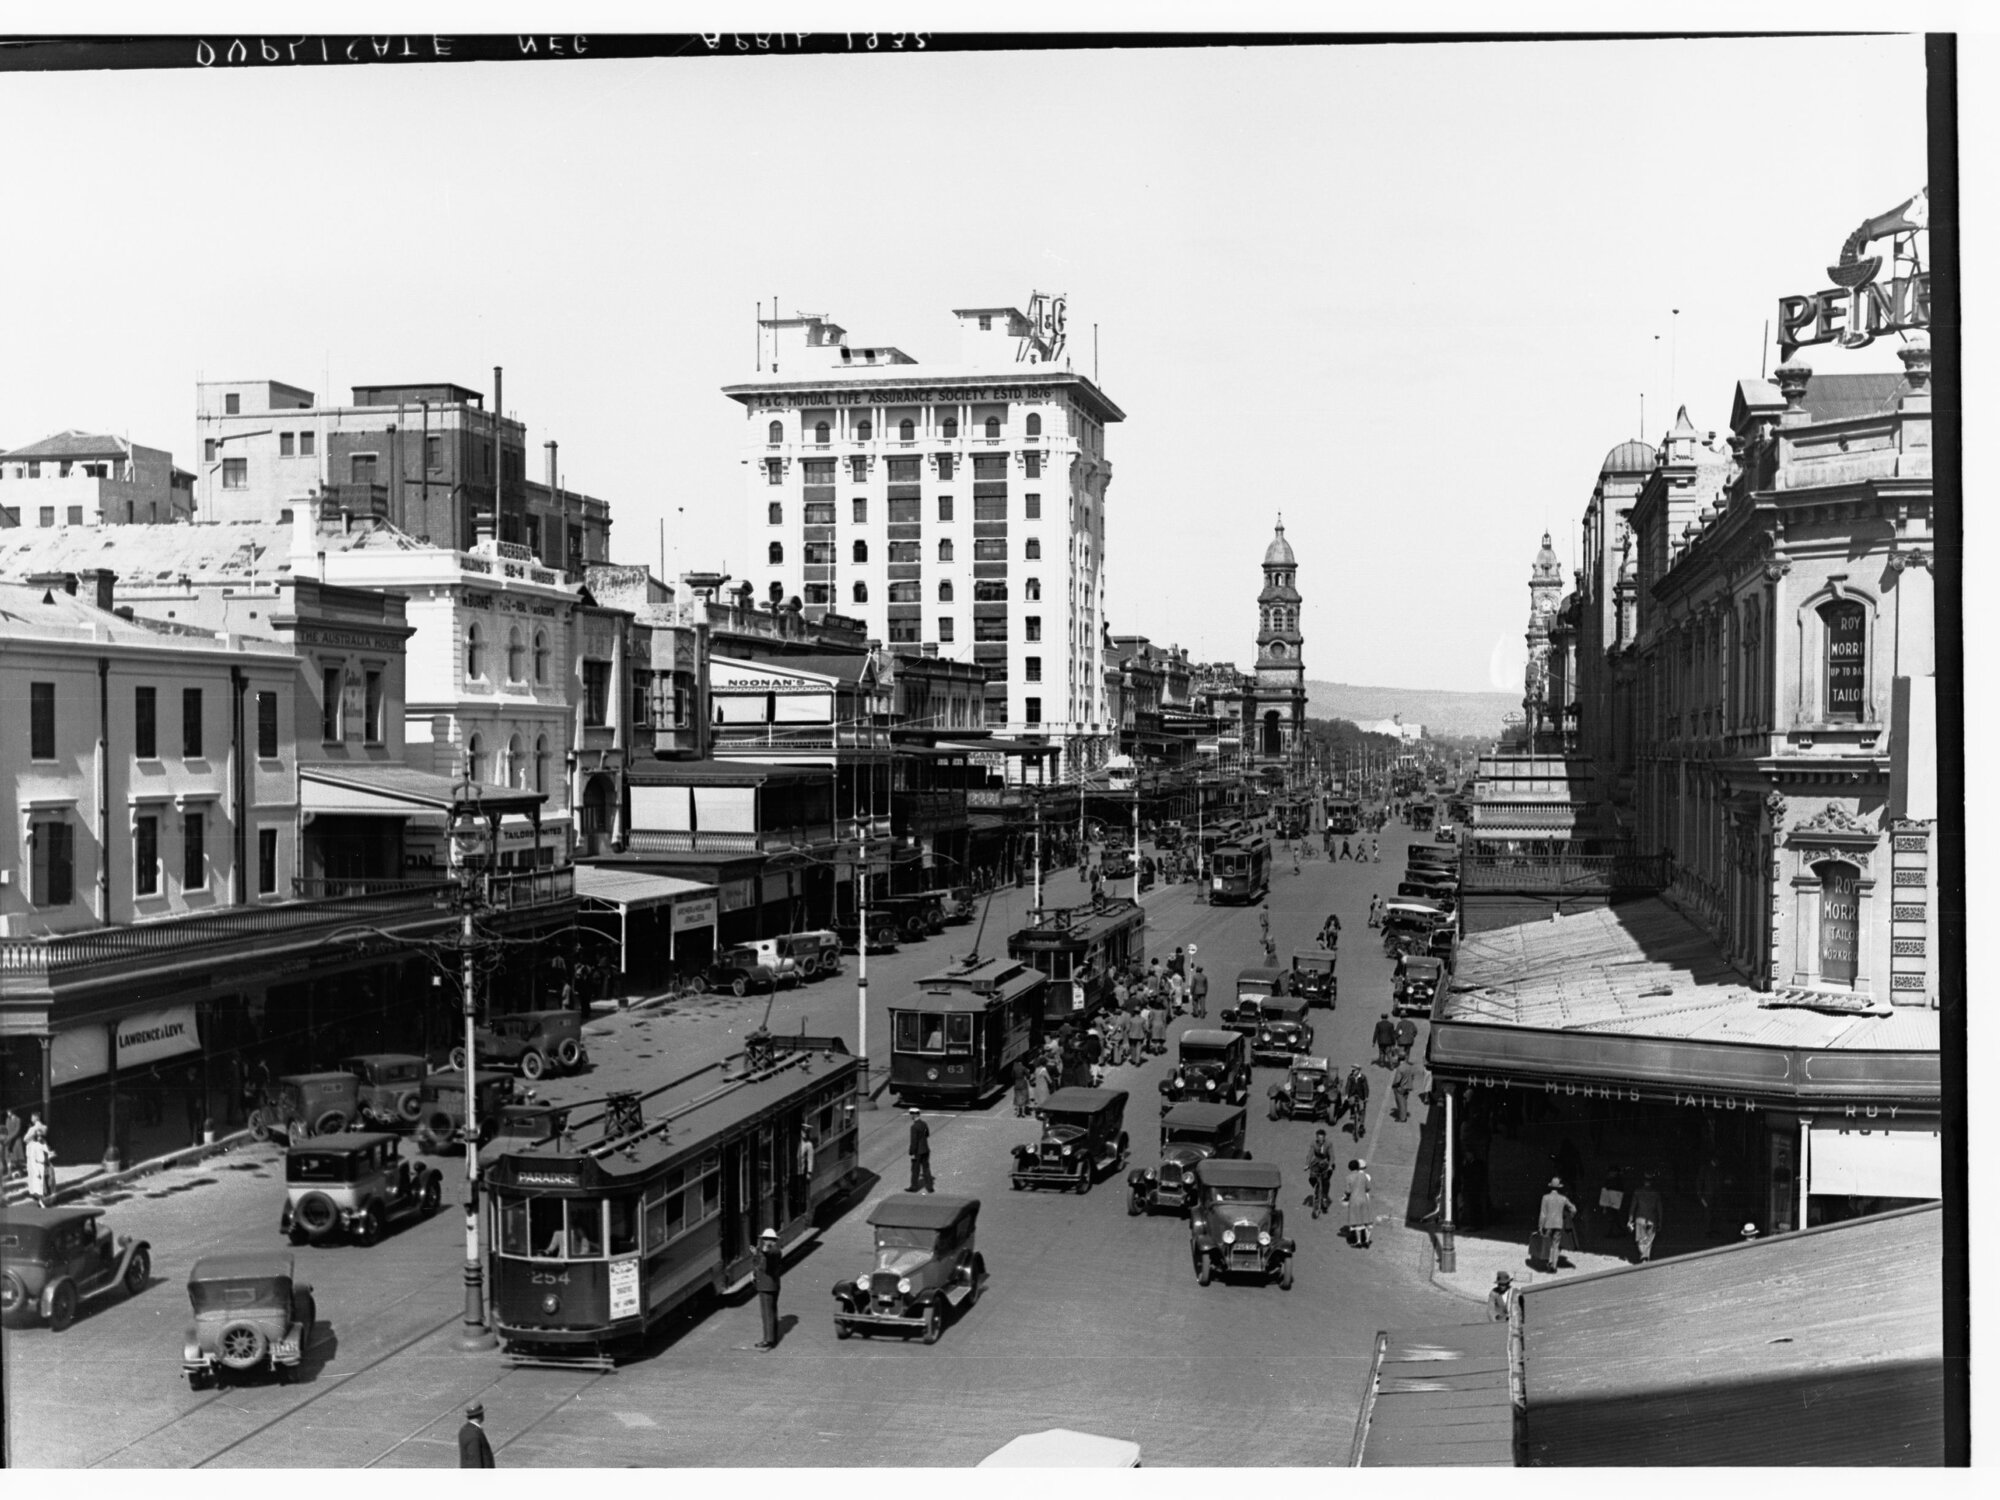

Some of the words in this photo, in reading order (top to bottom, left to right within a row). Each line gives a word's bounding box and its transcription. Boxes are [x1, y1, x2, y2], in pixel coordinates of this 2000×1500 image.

[788, 391, 831, 406] MUTUAL
[837, 389, 861, 404] LIFE
[868, 389, 933, 403] ASSURANCE
[1841, 616, 1860, 630] ROY
[302, 631, 318, 642] THE
[322, 631, 371, 647] AUSTRALIA
[374, 637, 401, 649] HOUSE
[1830, 667, 1840, 676] UP
[1842, 667, 1850, 676] TO
[728, 679, 805, 687] NOONAN'S
[1835, 876, 1856, 894] ROY
[119, 1027, 160, 1048] LAWRENCE
[947, 1064, 964, 1074] 63
[1468, 1075, 1511, 1089] ROY
[1545, 1081, 1640, 1102] MORRIS
[1674, 1092, 1757, 1112] TAILOR
[1845, 1105, 1898, 1118] ROY
[518, 1171, 576, 1184] PARADISE
[531, 1271, 571, 1285] 254
